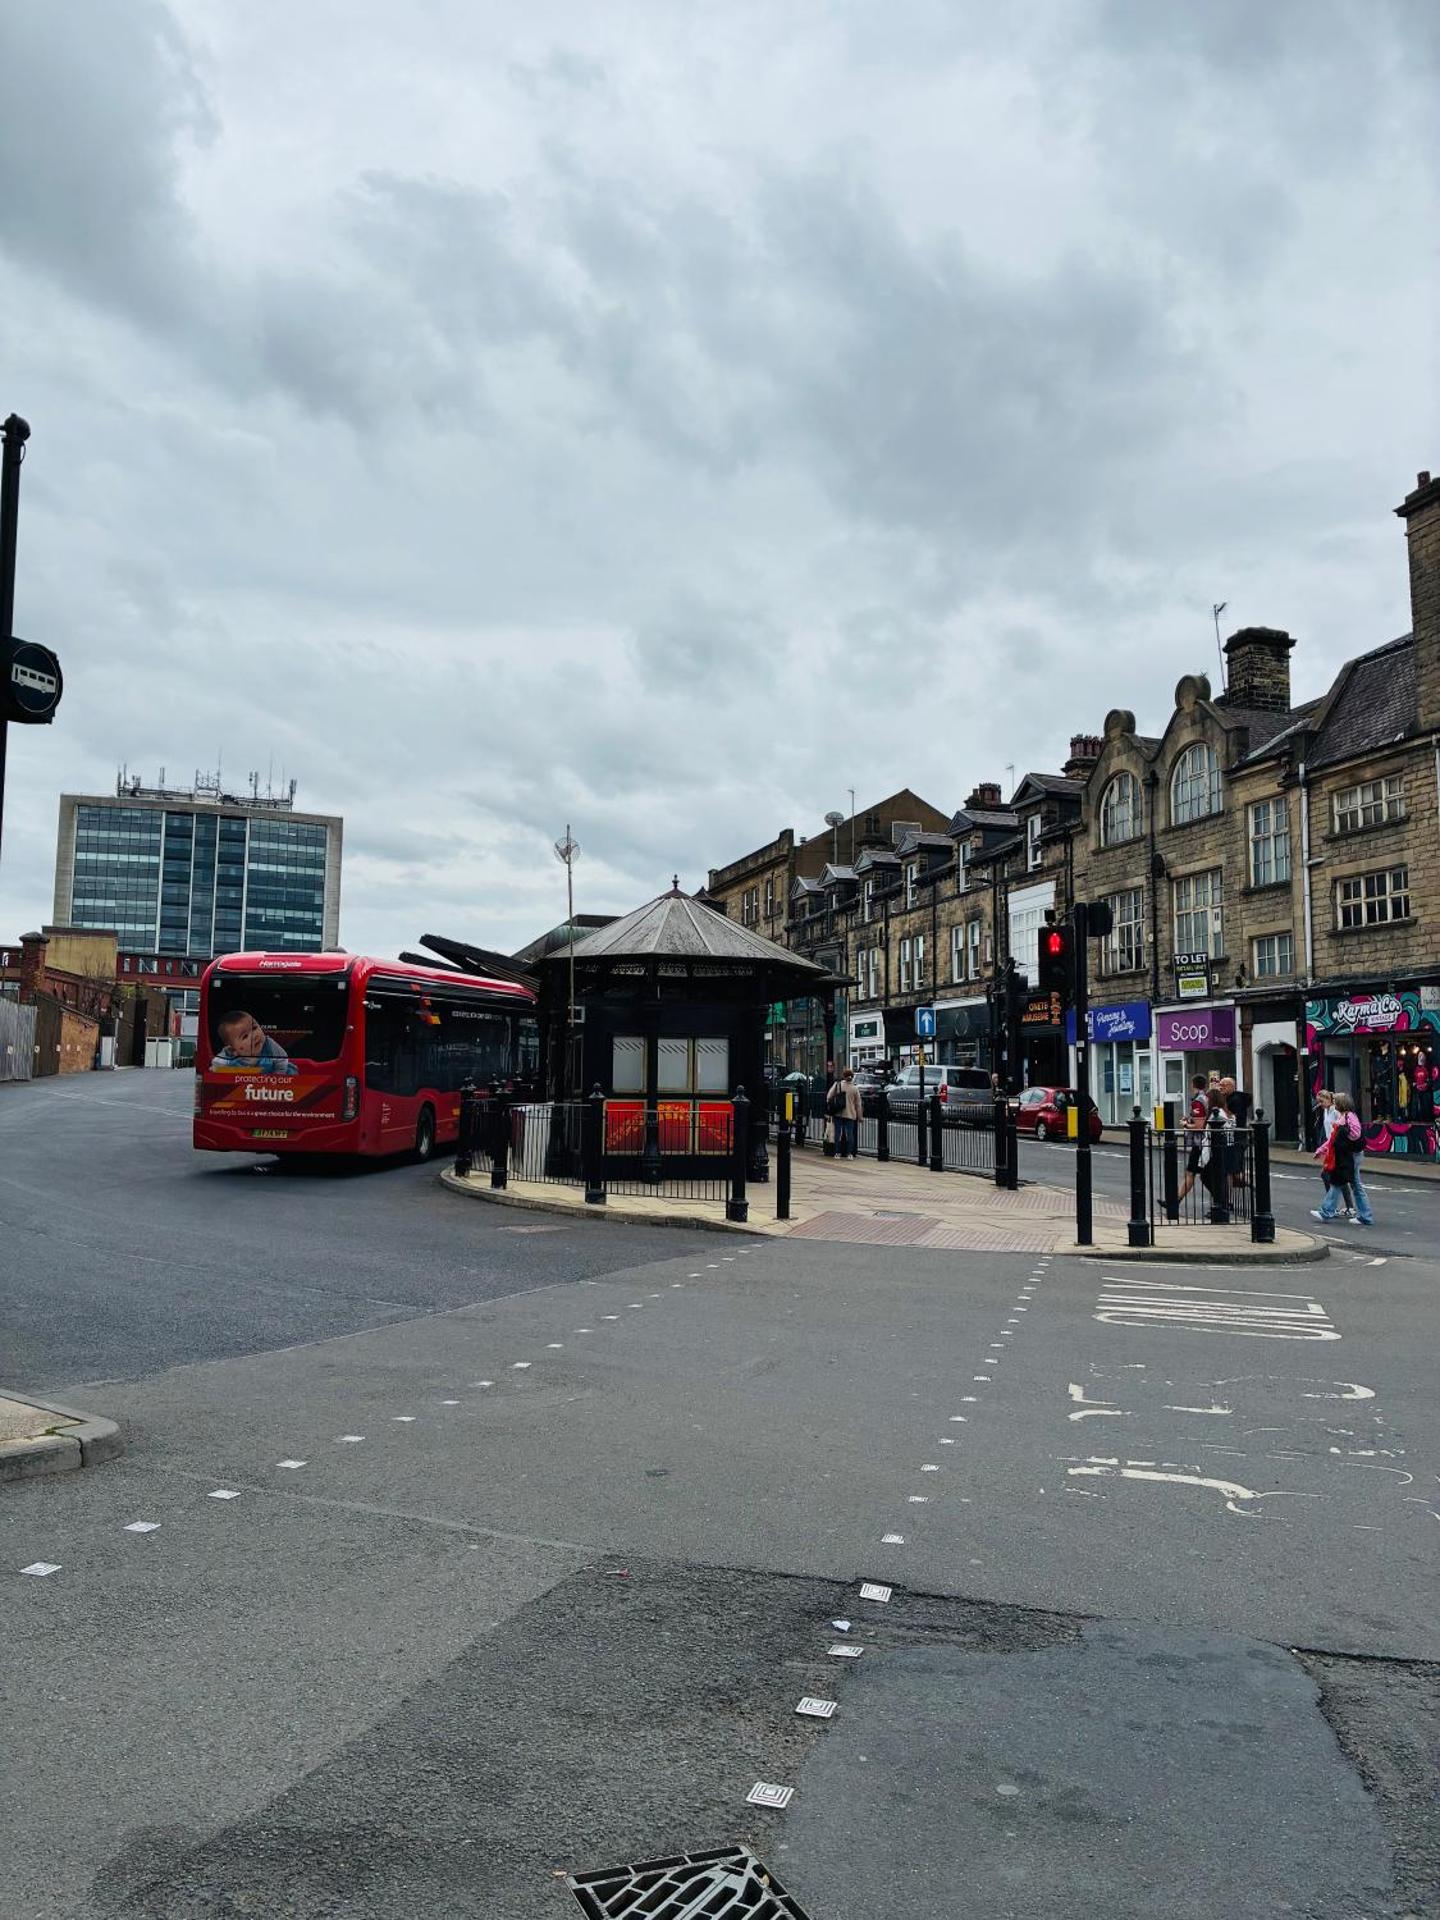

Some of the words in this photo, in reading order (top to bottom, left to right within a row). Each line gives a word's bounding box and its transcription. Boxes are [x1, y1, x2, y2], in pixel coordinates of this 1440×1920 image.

[1175, 955, 1189, 964] TO
[1191, 953, 1207, 963] LET
[1338, 1001, 1377, 1023] Karma
[1171, 1022, 1208, 1044] Scop
[235, 1075, 277, 1085] protecting
[278, 1076, 294, 1084] our
[245, 1084, 294, 1101] future
